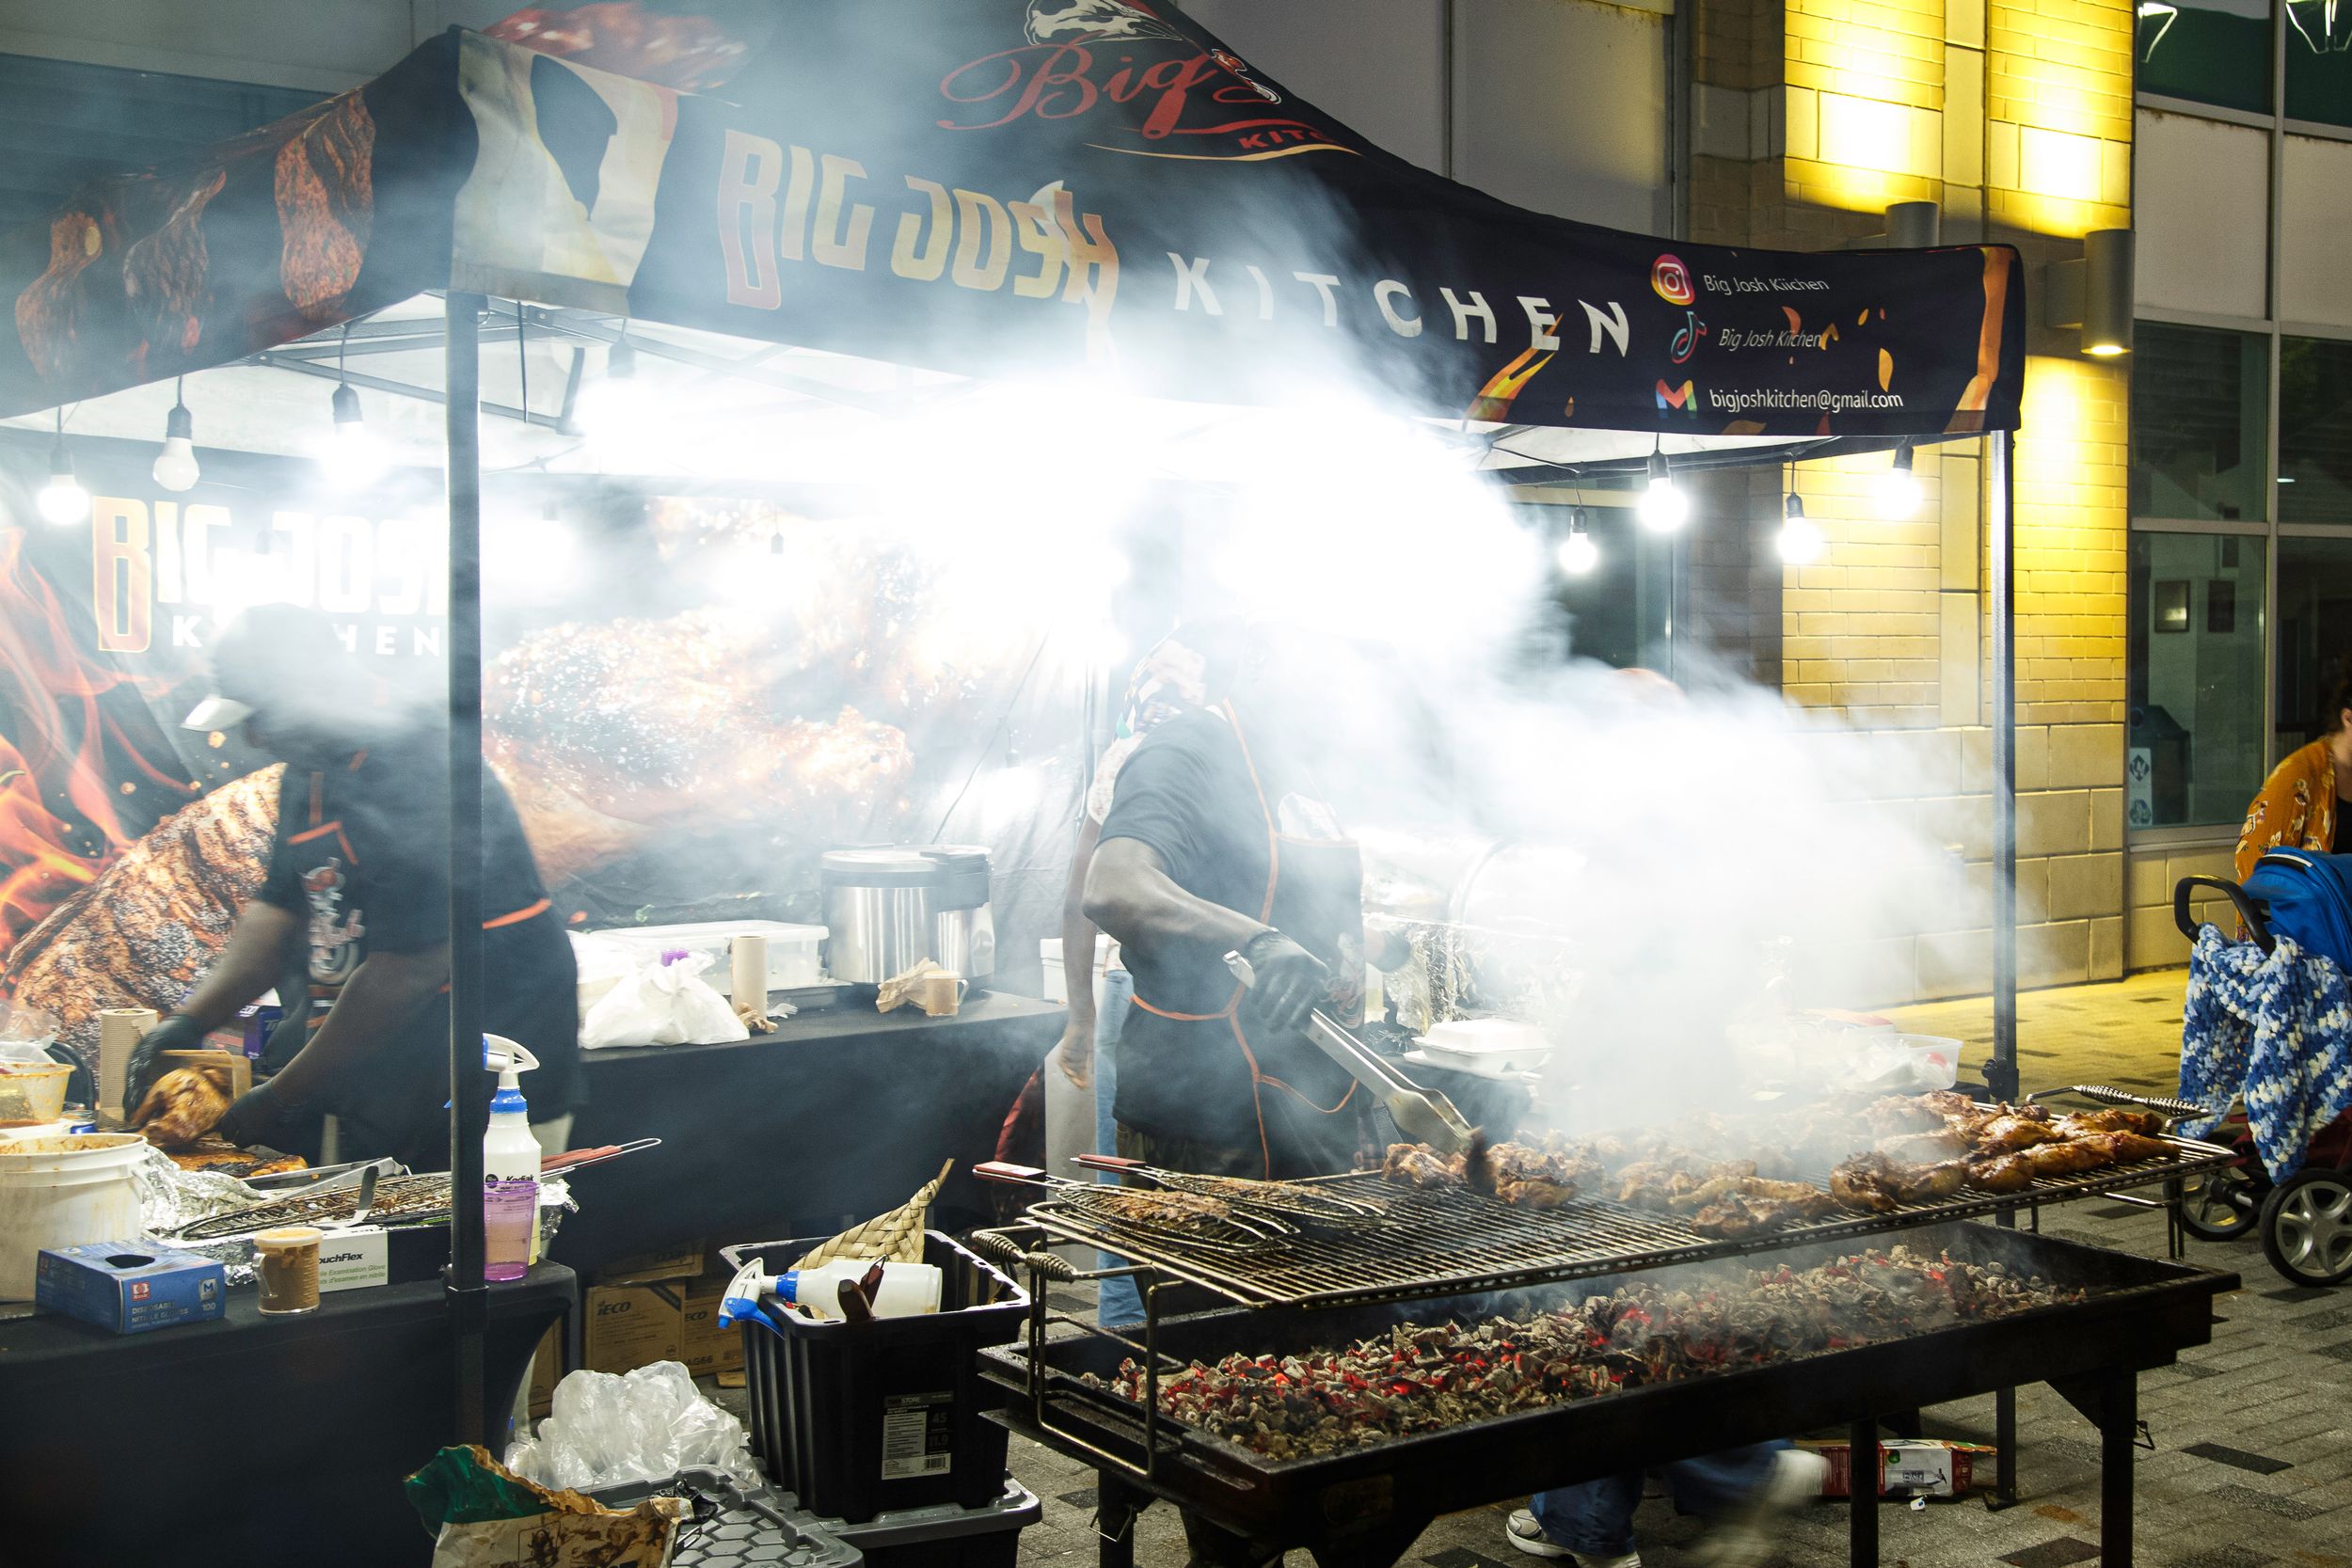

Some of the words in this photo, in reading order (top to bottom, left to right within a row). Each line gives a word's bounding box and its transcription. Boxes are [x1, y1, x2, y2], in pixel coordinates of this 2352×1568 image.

[718, 129, 875, 309] BIG
[891, 175, 1120, 309] JOSH
[1167, 252, 1629, 357] KITCHEN
[1704, 275, 1732, 296] Big
[1733, 277, 1770, 293] Josh
[1719, 328, 1742, 352] Big
[1742, 329, 1773, 347] Josh
[1709, 389, 1904, 414] bigjoshkitchen@gmail.com
[93, 495, 232, 653] BIG
[172, 615, 441, 657] KHEN
[319, 1253, 363, 1264] ouchFlex
[203, 1283, 214, 1292] M
[202, 1303, 216, 1311] 100
[685, 1311, 707, 1322] ECO
